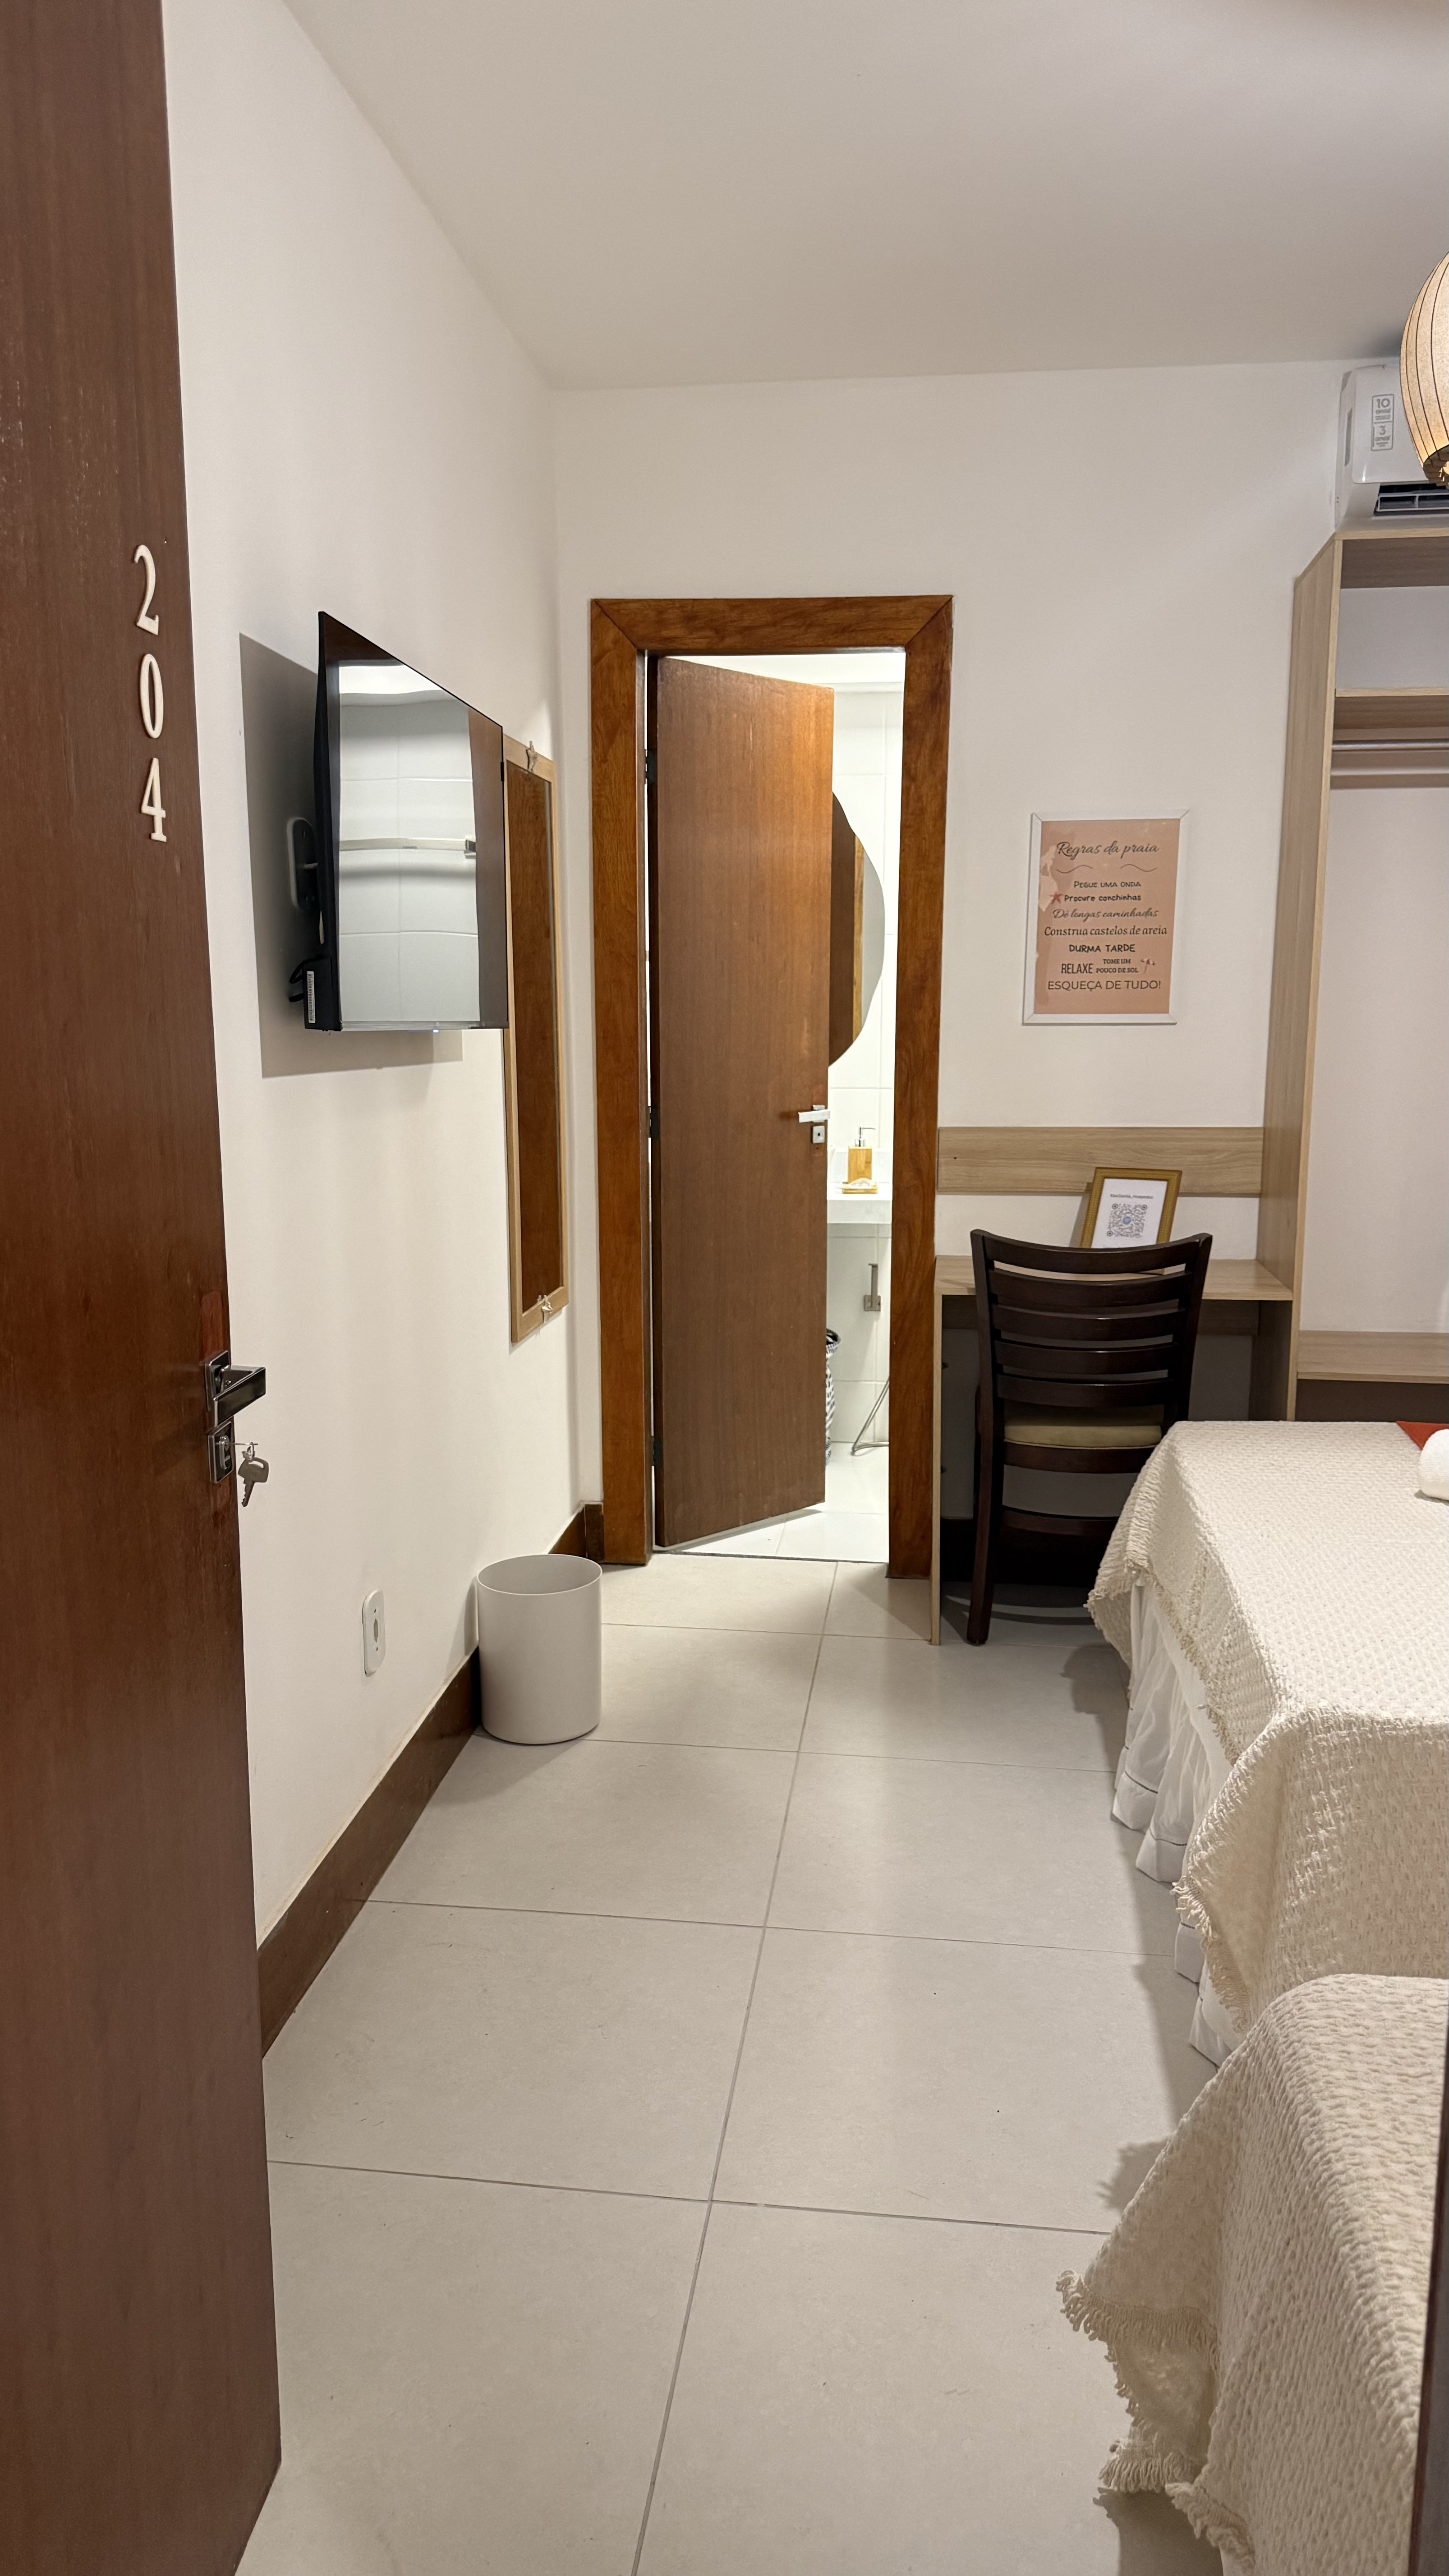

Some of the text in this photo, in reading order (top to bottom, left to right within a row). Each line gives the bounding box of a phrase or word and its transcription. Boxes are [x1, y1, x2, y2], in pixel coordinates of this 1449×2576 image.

[1376, 398, 1390, 408] 10
[134, 545, 167, 842] 204
[1057, 840, 1159, 860] Regras da praia
[1071, 909, 1101, 922] longas
[1103, 907, 1159, 918] caminhadas
[1044, 925, 1167, 936] Construa castelos de areia
[1069, 944, 1136, 953] DURMA TARDE
[1061, 963, 1094, 974] RELAXE
[1048, 980, 1161, 991] ESQUEÇA DE TUDO!
